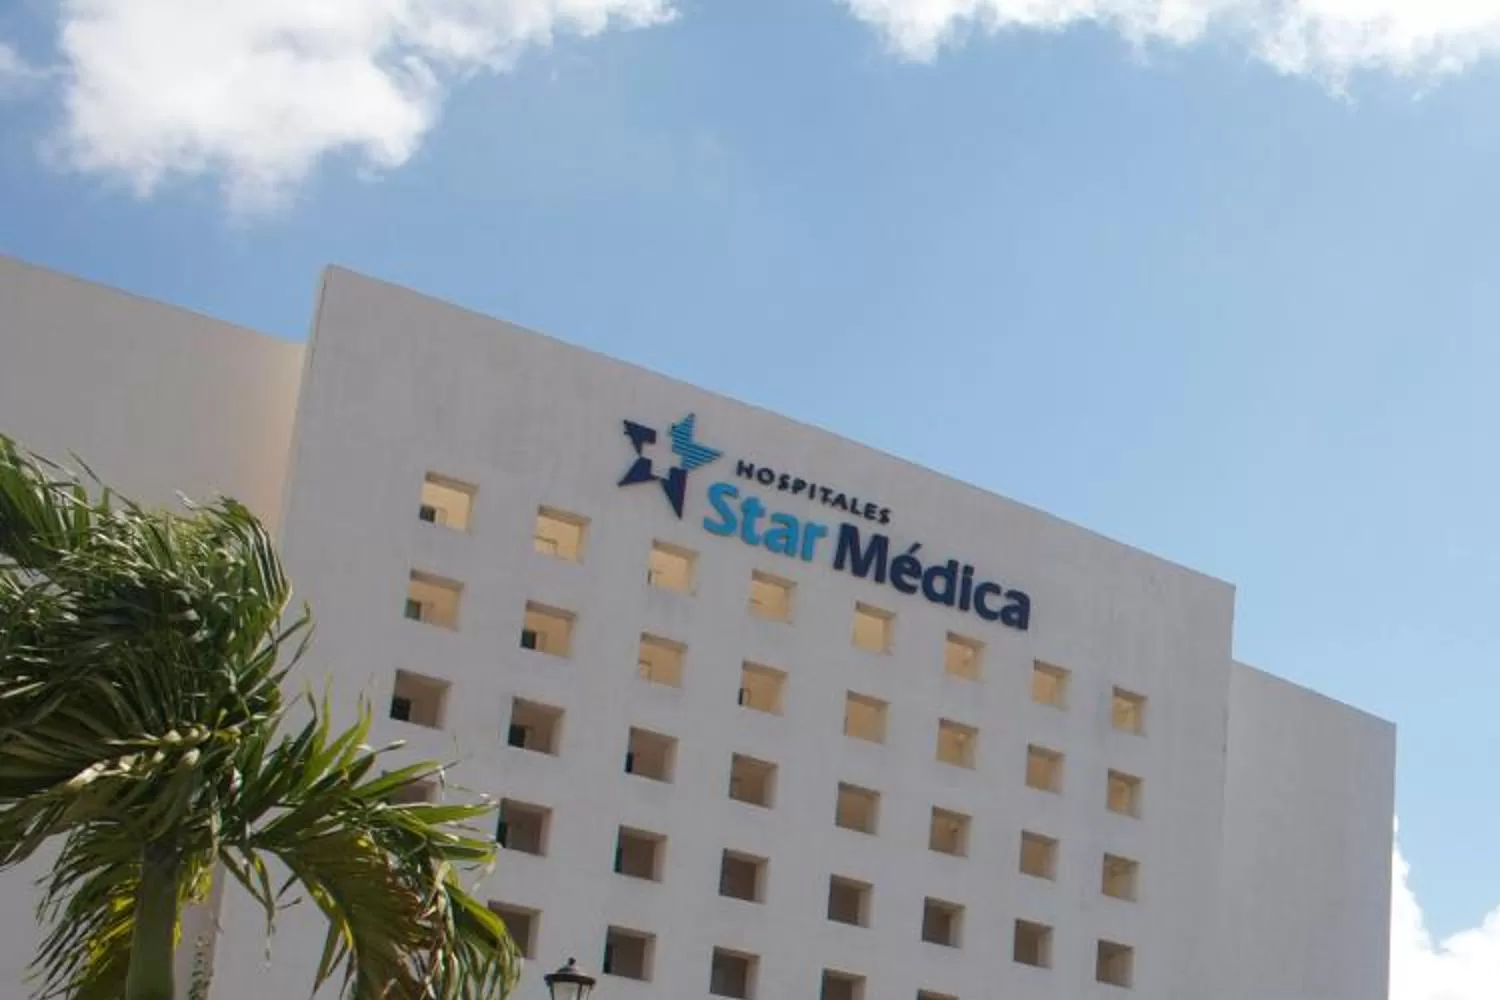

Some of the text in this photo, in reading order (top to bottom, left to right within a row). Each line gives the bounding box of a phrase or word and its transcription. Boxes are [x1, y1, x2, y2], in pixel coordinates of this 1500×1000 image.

[735, 459, 892, 525] HOSPITALES
[703, 482, 1031, 631] Star Médica
